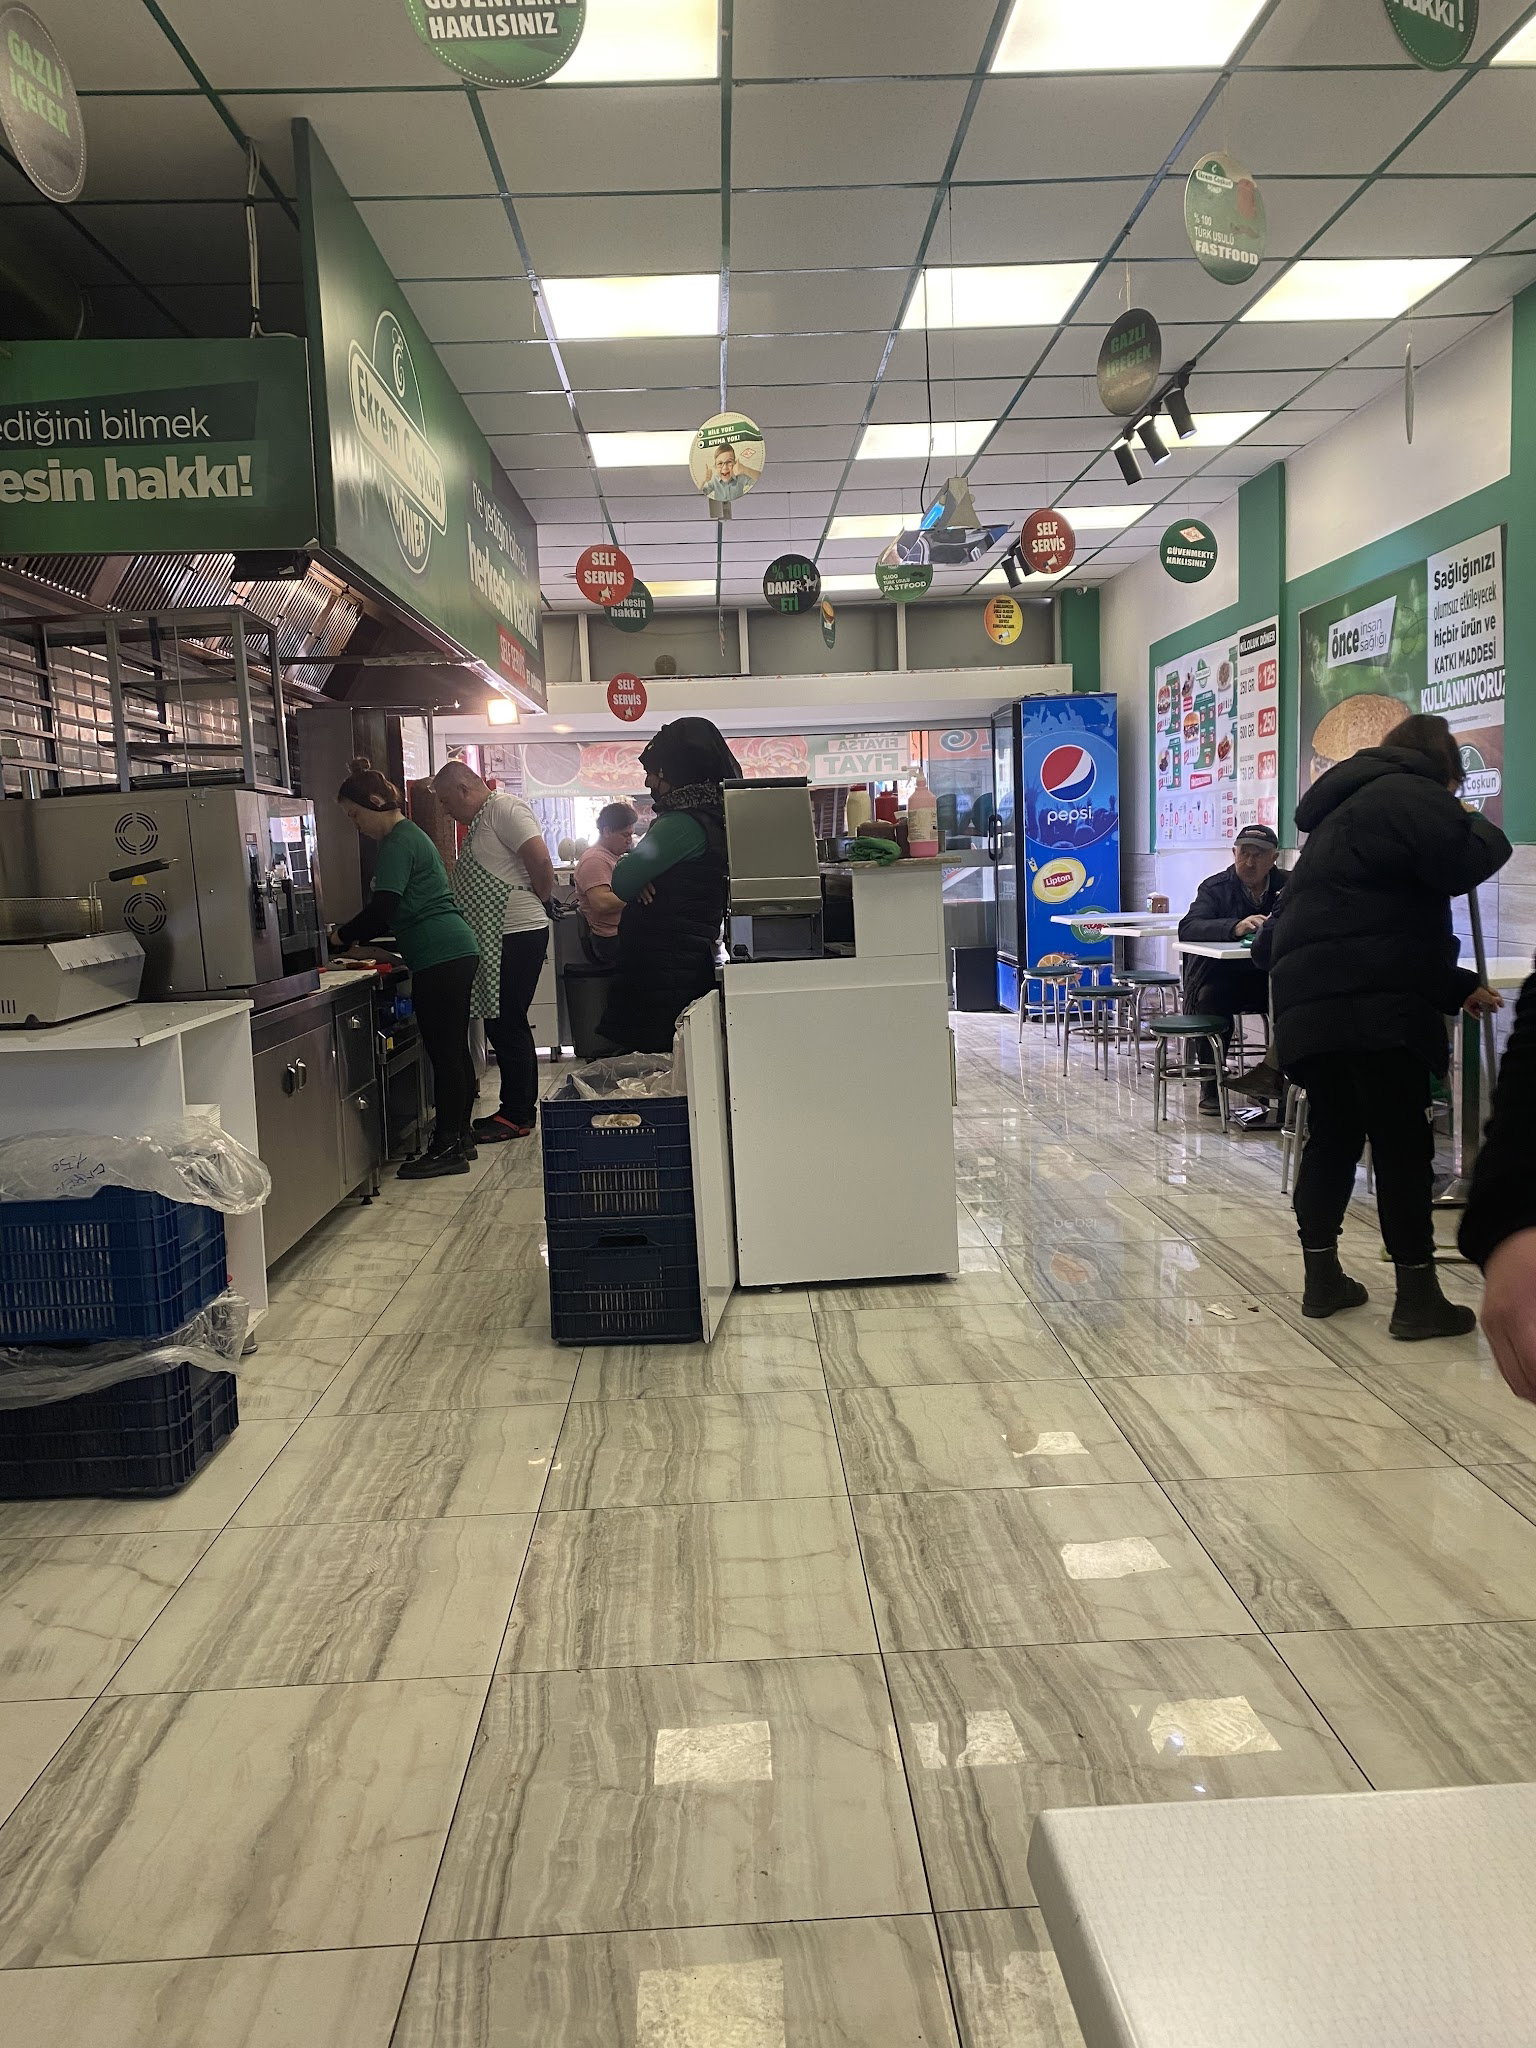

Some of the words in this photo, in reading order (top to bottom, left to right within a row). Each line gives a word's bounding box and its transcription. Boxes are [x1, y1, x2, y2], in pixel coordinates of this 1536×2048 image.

[428, 12, 558, 39] HAKLISINIZ
[8, 30, 63, 99] GAZLI
[1194, 225, 1212, 240] TÜRK
[1195, 239, 1259, 265] FASTFOOD
[1110, 323, 1146, 353] GAZLI
[0, 408, 92, 446] diğini
[100, 406, 211, 440] bilmek
[357, 364, 400, 458] Ekrem
[404, 428, 442, 511] Coşkun
[104, 455, 253, 501] hakkı!
[472, 480, 483, 518] ne
[391, 484, 426, 557] DÖNER
[1036, 521, 1058, 536] SELF
[1032, 536, 1066, 553] SERVİS
[1167, 546, 1214, 559] GÜVENMEKTE
[591, 552, 617, 566] SELF
[1166, 556, 1207, 568] HAKLISINIZ
[467, 522, 513, 625] herkesin
[583, 569, 625, 585] SERVİS
[1434, 551, 1496, 591] Sağlığınızı
[767, 581, 798, 595] DANA
[883, 581, 926, 592] FASTFOOD
[612, 597, 646, 607] rkesin
[781, 595, 799, 611] ETİ
[1434, 598, 1459, 620] olumsuz
[1460, 580, 1497, 611] etkileyecek
[1332, 627, 1359, 659] önce
[1360, 619, 1382, 636] insan
[1360, 631, 1387, 652] sağlığı
[1434, 623, 1459, 648] hiçbir
[1460, 617, 1482, 639] ürün
[1484, 615, 1496, 631] ve
[1434, 652, 1457, 674] KATKI
[1458, 636, 1496, 668] MADDESİ
[617, 679, 635, 690] SELF
[612, 692, 642, 705] SERVİS
[1466, 775, 1497, 793] Coşkun
[1047, 805, 1092, 825] pepsi
[1045, 873, 1071, 886] Lipton
